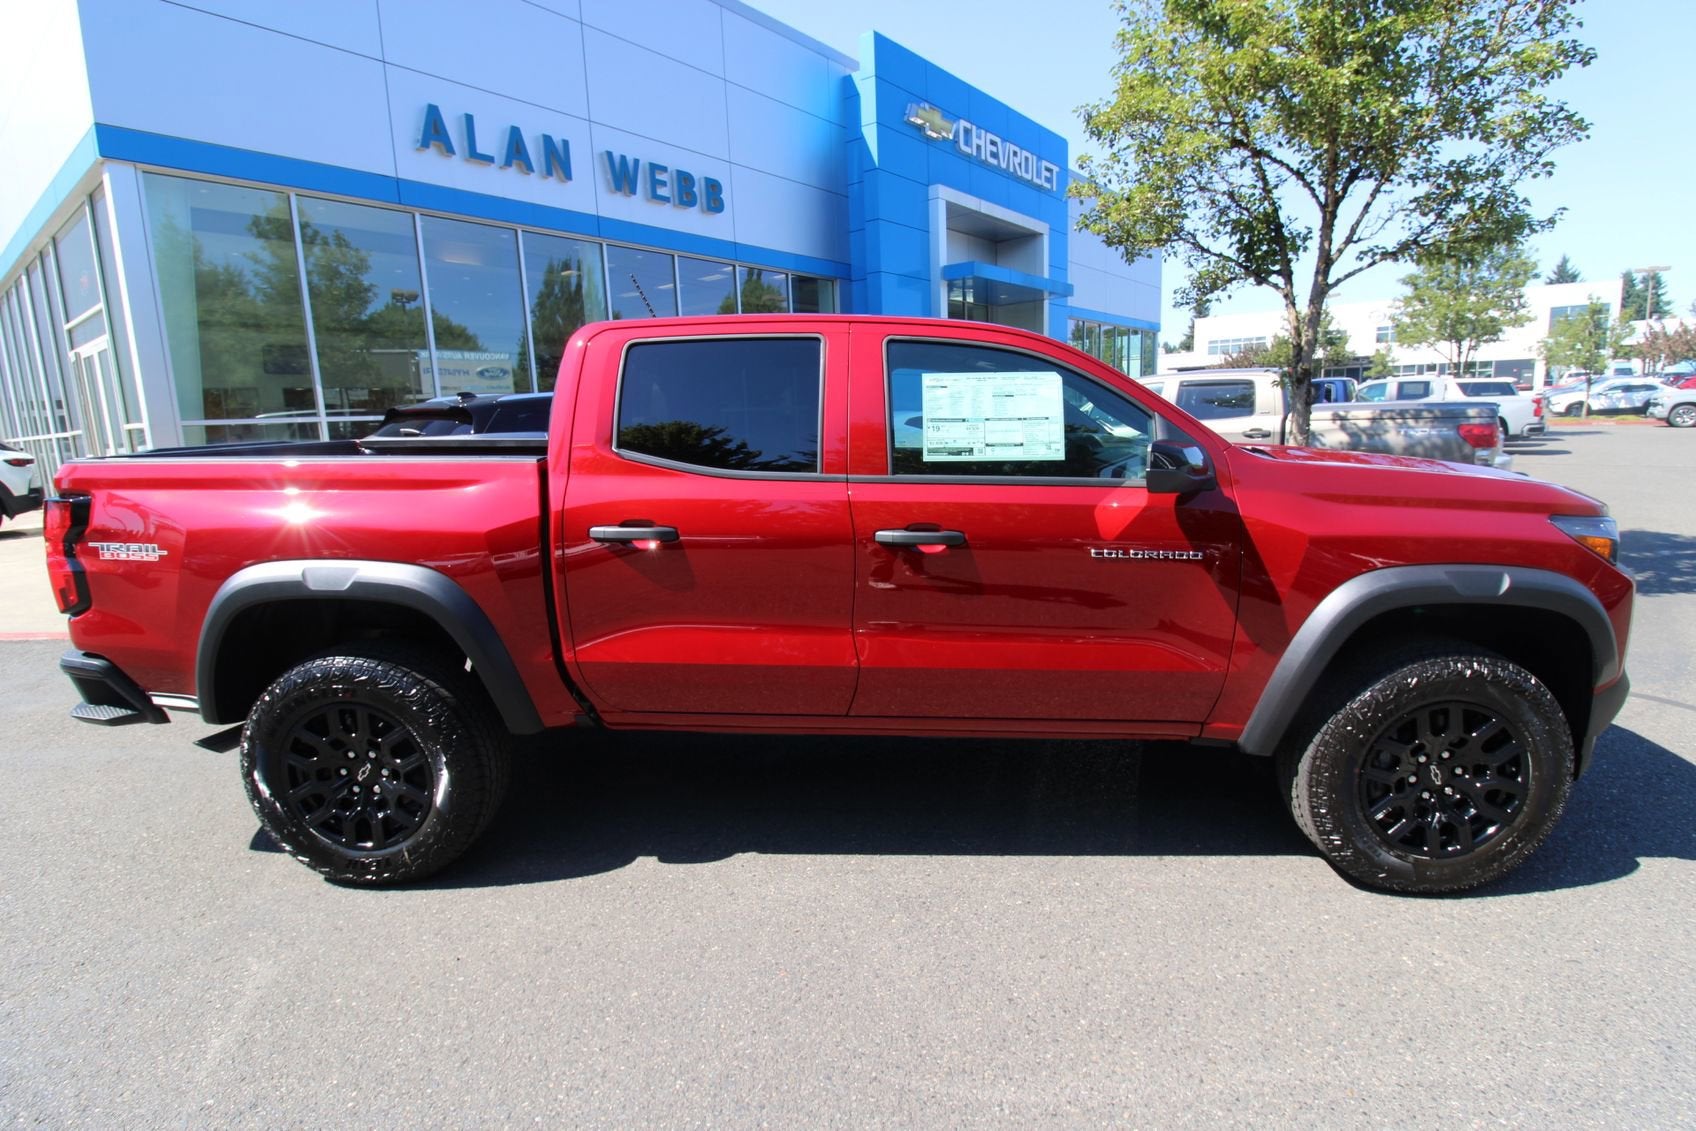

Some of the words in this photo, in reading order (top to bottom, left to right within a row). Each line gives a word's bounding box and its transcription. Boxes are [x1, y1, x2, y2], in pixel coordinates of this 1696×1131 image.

[417, 103, 573, 182] ALAN
[604, 150, 725, 214] WEBB
[958, 119, 1060, 191] CHEVROLET
[88, 542, 168, 555] TRAIL
[1090, 548, 1204, 560] COLORADO
[99, 552, 159, 561] BOSS
